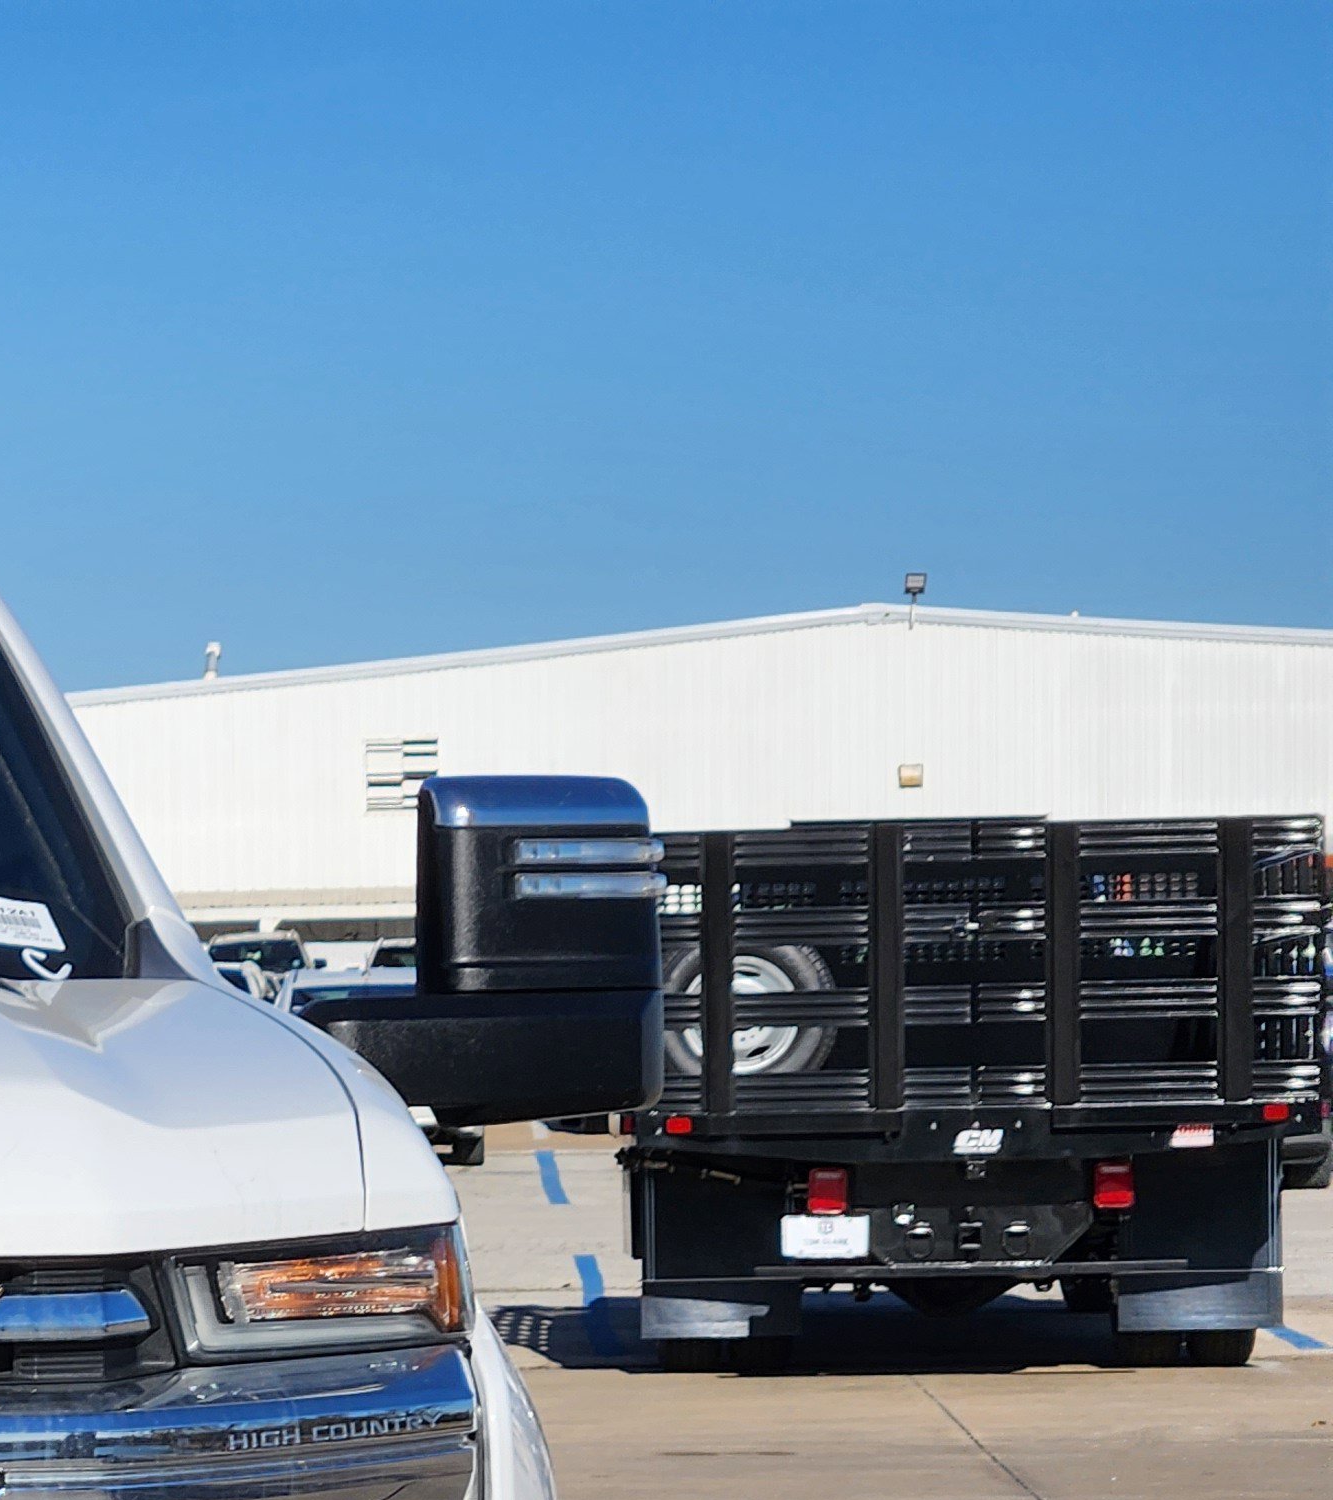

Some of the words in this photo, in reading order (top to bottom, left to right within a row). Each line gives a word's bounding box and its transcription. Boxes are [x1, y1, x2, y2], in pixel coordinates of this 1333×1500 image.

[953, 1128, 1004, 1150] CM
[229, 1427, 301, 1451] HIGH
[312, 1411, 444, 1443] COUNTRY
